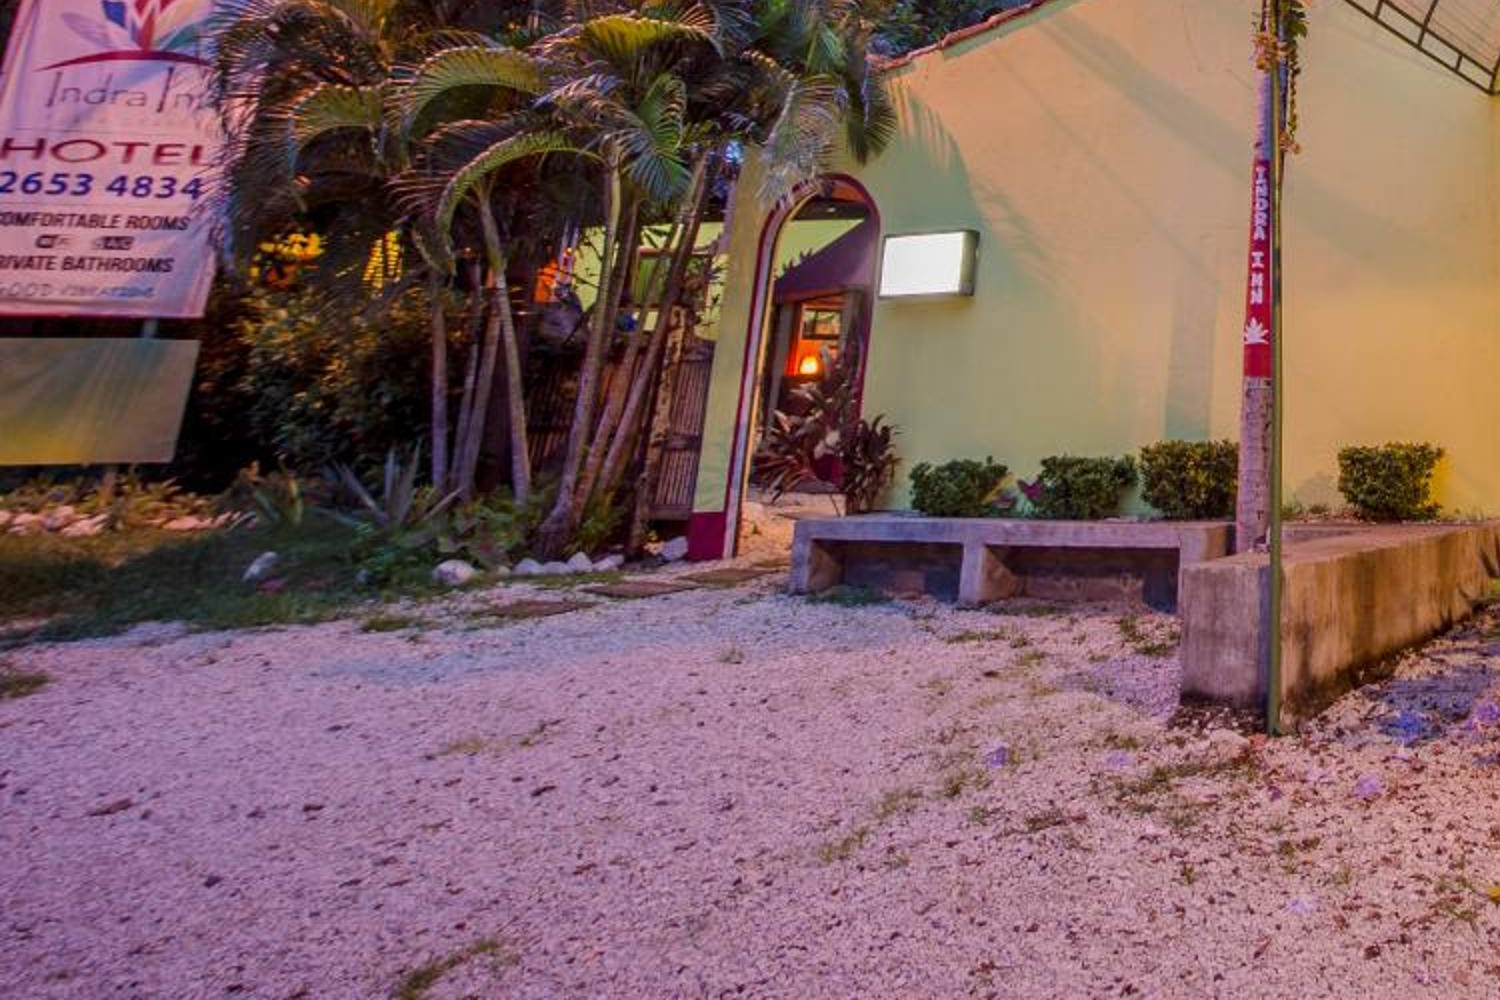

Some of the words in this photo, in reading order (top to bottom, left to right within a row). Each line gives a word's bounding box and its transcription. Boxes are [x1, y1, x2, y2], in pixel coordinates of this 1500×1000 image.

[46, 70, 148, 108] Indra
[0, 137, 213, 167] HOTEL
[0, 170, 94, 197] 2653
[106, 174, 203, 200] 4834
[1253, 166, 1269, 241] INDRA
[0, 211, 122, 229] OMFORTABLE
[124, 215, 192, 231] ROOMS
[61, 255, 175, 273] BATHROOMS
[1250, 251, 1265, 305] INN
